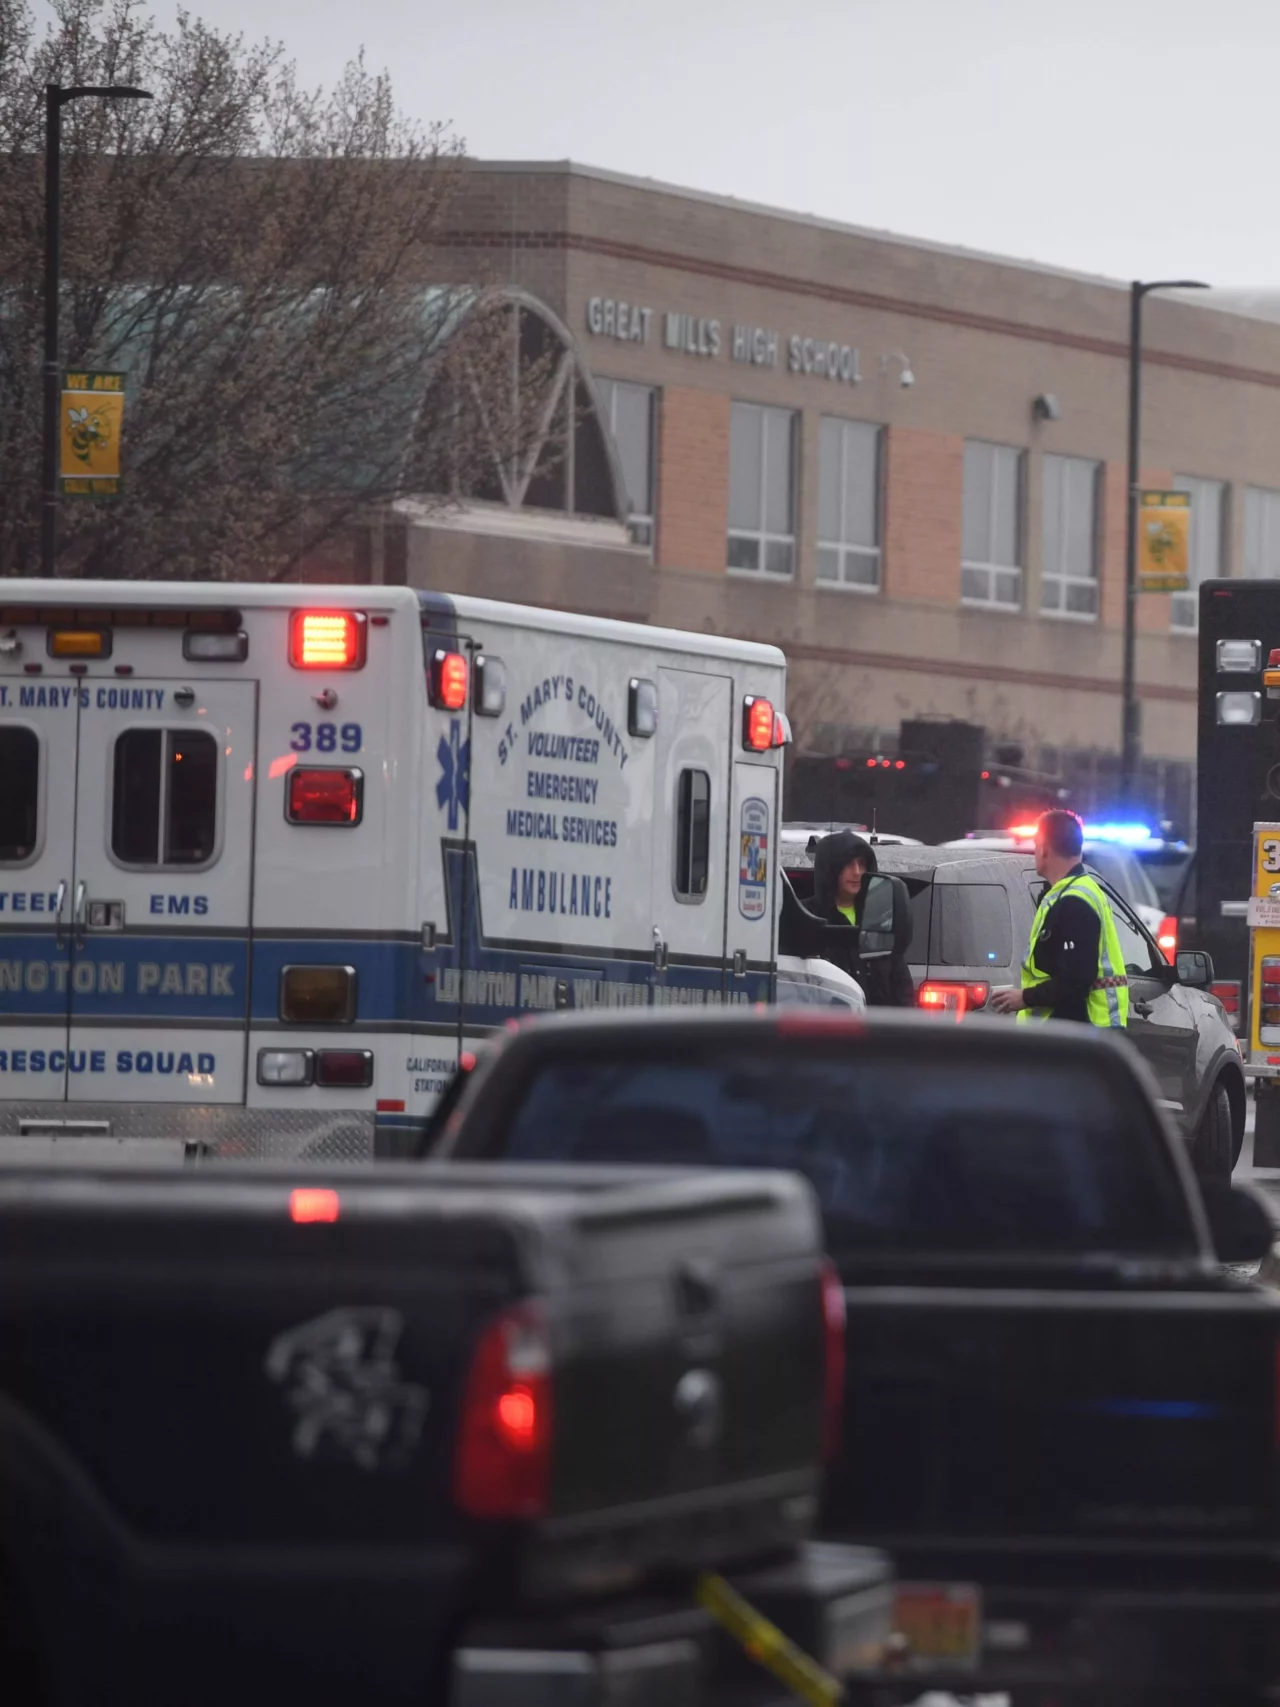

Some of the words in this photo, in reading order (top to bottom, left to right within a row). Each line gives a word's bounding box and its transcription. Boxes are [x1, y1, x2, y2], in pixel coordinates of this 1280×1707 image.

[588, 297, 653, 342] GREAT
[665, 312, 721, 355] MILLS
[732, 324, 778, 365] HIGH
[788, 334, 862, 382] SCHOOL
[19, 687, 90, 708] MARY'S
[97, 689, 164, 710] COUNTY
[290, 722, 362, 753] 389
[498, 725, 518, 766] ST.
[520, 675, 574, 725] MARY'S
[578, 685, 629, 770] COUNTY
[527, 732, 600, 764] VOLUNTEER
[527, 770, 599, 805] EMERGENCY
[506, 810, 559, 841] MEDICAL
[562, 816, 617, 848] SERVICES
[150, 895, 209, 915] EMS
[509, 867, 612, 919] AMBULANCE
[137, 962, 235, 996] PARK
[520, 973, 556, 1010] PARK
[116, 1051, 216, 1075] SQUAD
